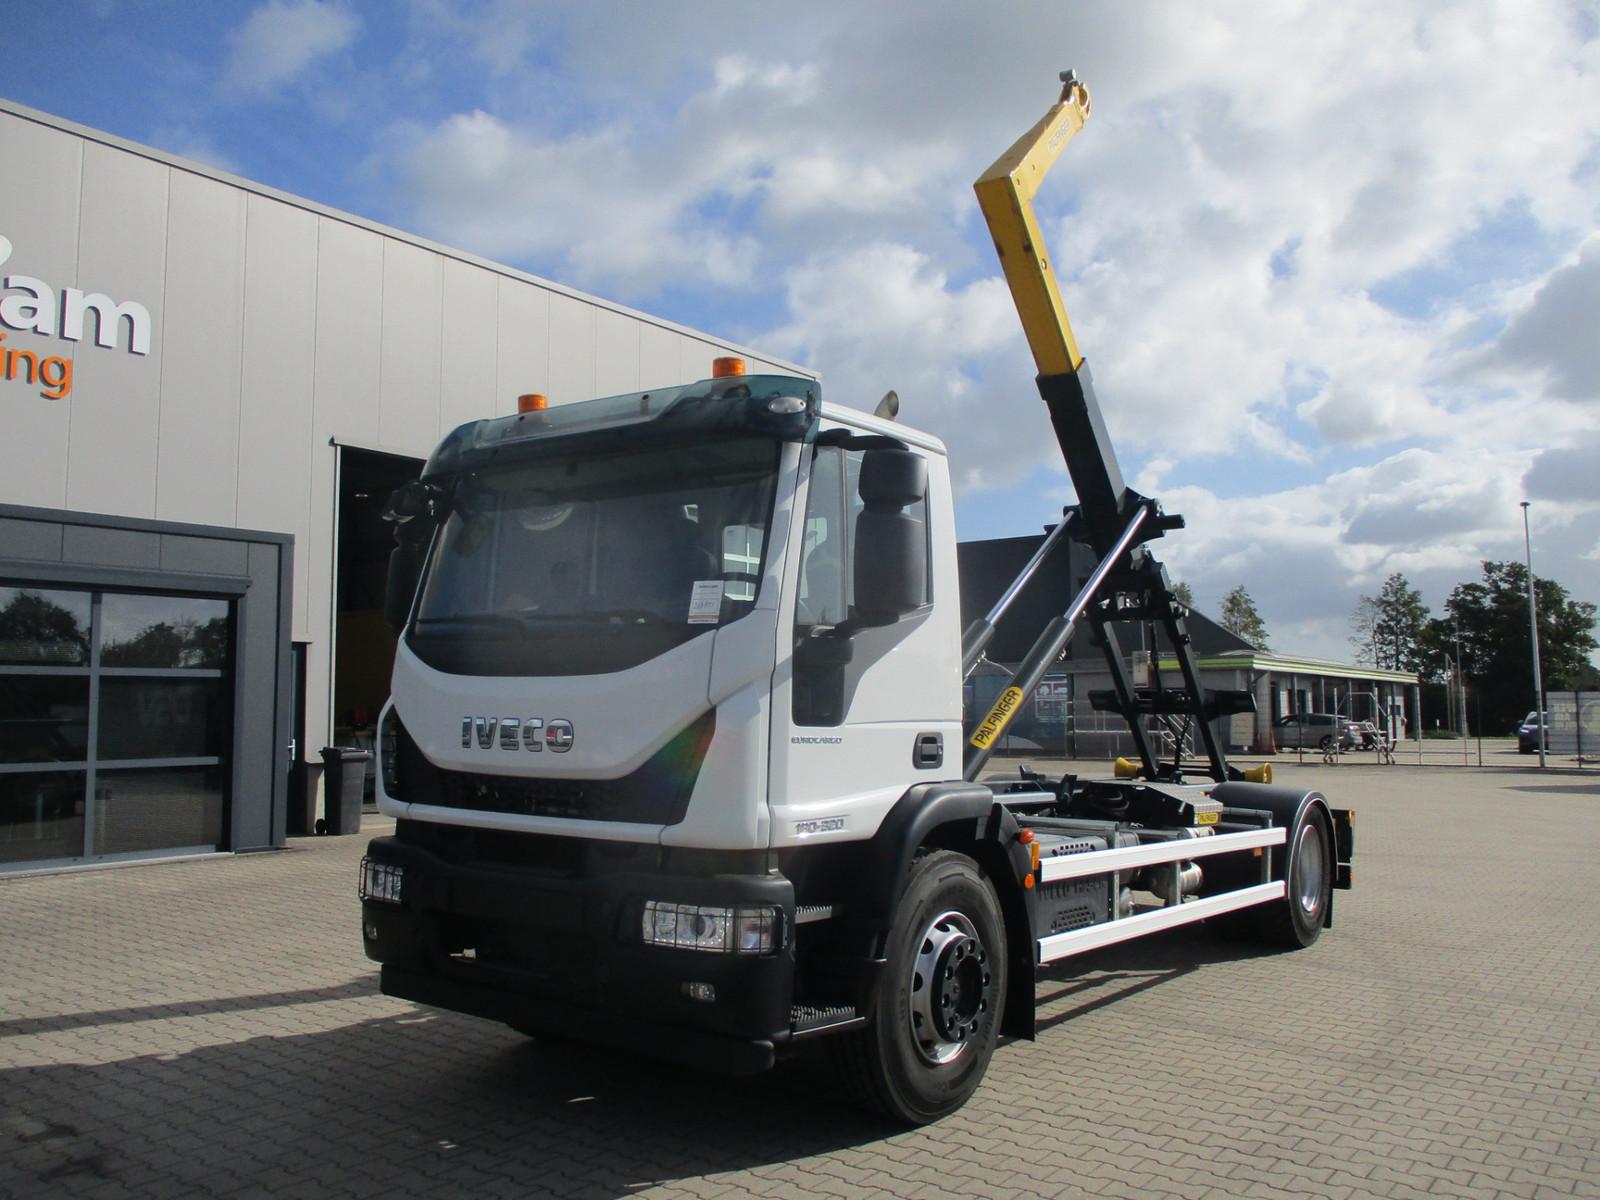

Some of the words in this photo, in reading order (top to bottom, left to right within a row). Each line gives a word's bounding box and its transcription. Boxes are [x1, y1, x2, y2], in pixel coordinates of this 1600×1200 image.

[461, 716, 574, 753] IVECO
[974, 689, 1020, 745] PALFINGER
[791, 736, 843, 745] EUROCARGO
